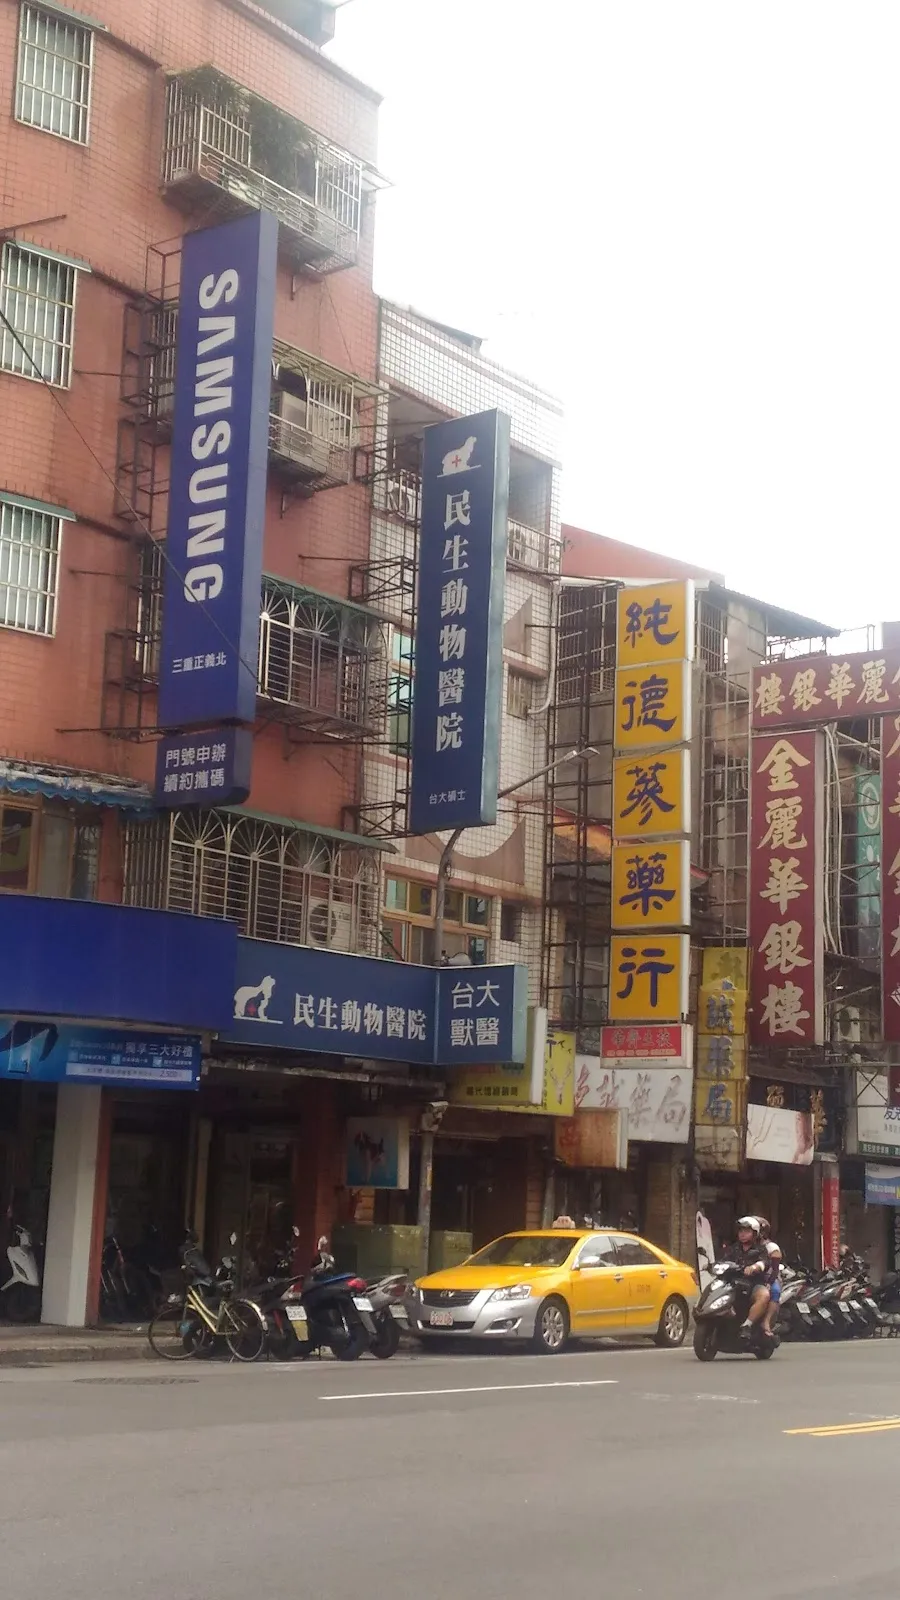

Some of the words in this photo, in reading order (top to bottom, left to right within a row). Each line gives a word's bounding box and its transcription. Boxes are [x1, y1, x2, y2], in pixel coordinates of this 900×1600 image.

[183, 268, 240, 604] SAMSUNG
[435, 493, 472, 752] 民生動物醫院
[172, 651, 227, 674] 三重正義北
[165, 743, 226, 769] 門號申辦
[163, 767, 225, 793] 續約攜碼
[429, 789, 466, 805] 台大碩士
[757, 739, 812, 1037] 金麗華銀樓
[451, 979, 500, 1010] 台大
[293, 992, 427, 1041] 民生動物醫院
[450, 1016, 500, 1047] 獸醫
